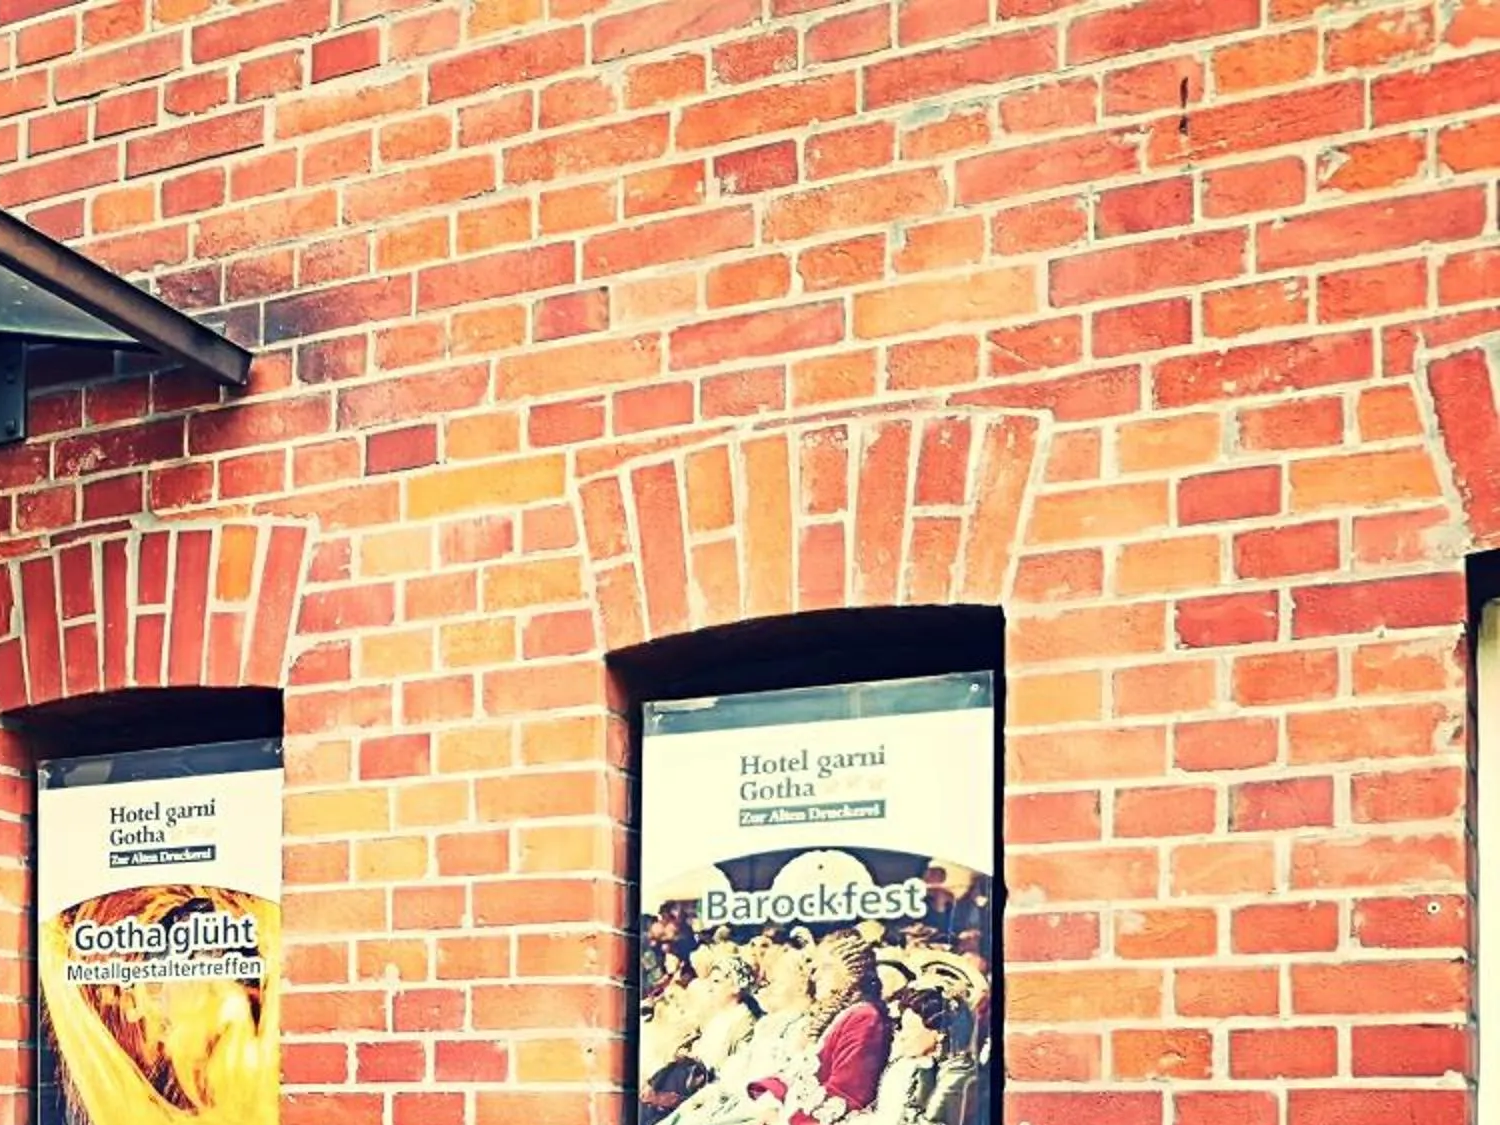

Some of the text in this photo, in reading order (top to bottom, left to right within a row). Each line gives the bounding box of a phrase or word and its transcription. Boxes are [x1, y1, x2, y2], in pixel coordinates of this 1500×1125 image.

[740, 744, 886, 778] Hotel garni
[739, 777, 816, 801] Gotha
[109, 798, 216, 827] Hotel garni
[109, 826, 166, 846] Gotha
[706, 881, 922, 921] Barockfest
[74, 916, 255, 954] Gotha glüht
[67, 957, 262, 983] Metallgestaltertreffen
